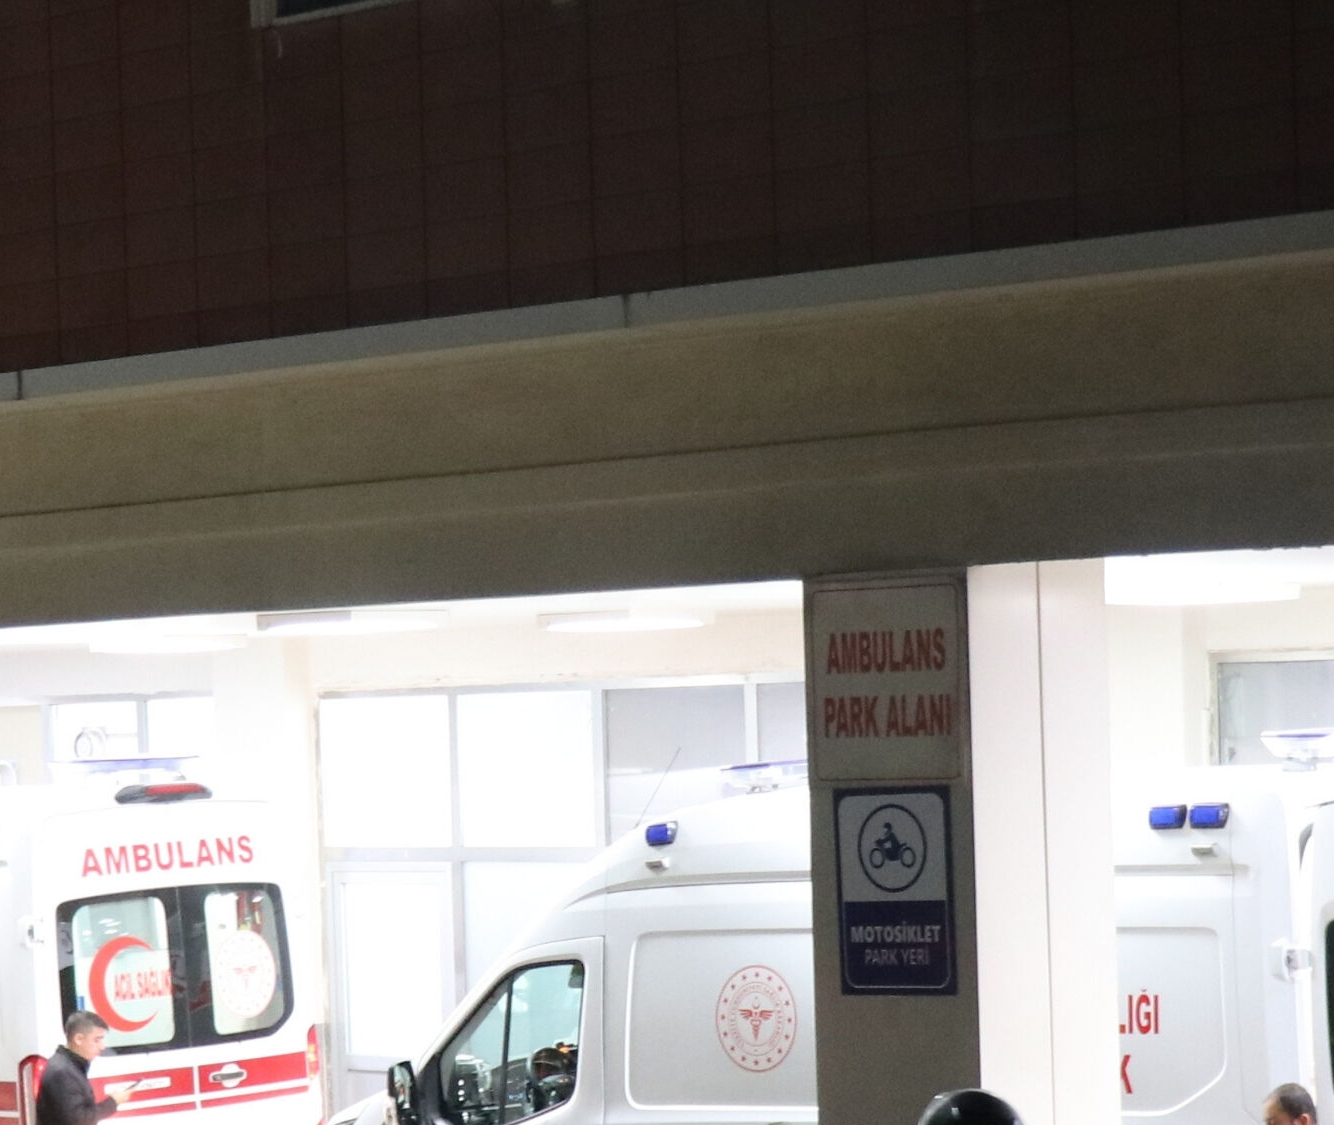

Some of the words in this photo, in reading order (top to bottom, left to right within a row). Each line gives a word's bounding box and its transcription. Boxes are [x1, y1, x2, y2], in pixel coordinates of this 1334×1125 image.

[826, 627, 946, 674] AMBULANS
[824, 695, 879, 738] PARK
[886, 693, 952, 737] ALANI
[81, 835, 254, 878] AMBULANS
[851, 921, 941, 943] MOTOSİKLET
[865, 949, 898, 966] PARK
[1119, 988, 1159, 1034] IĞI
